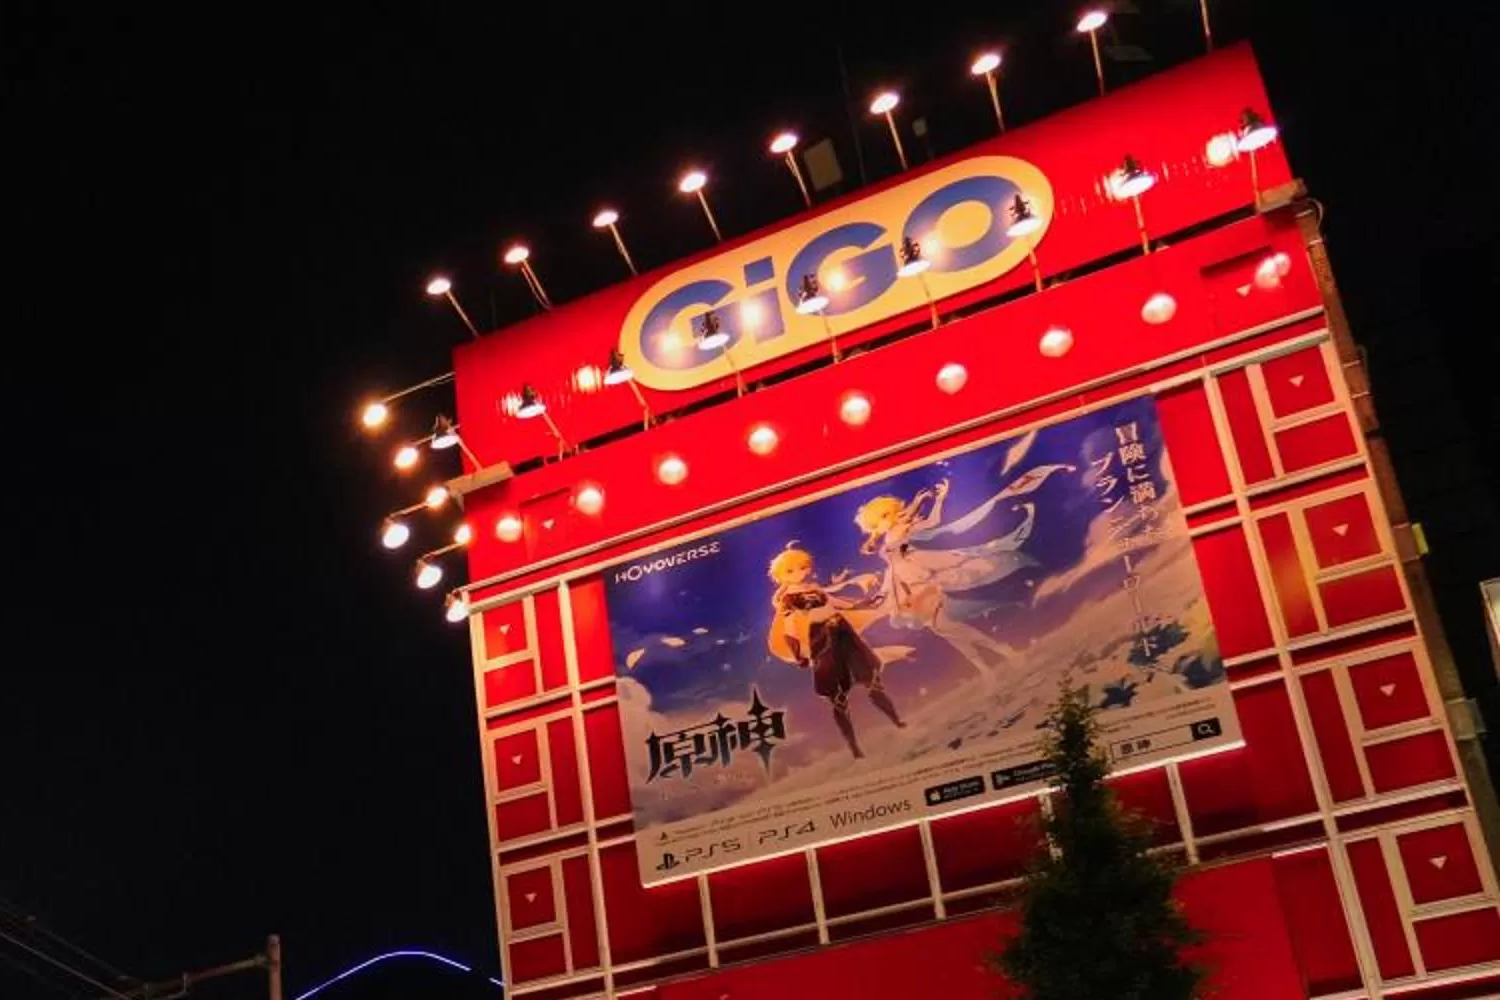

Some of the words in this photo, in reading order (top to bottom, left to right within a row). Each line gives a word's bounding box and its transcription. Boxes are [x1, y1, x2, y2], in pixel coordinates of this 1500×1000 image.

[639, 175, 1028, 369] GiGO
[614, 541, 721, 584] HOYOVERSE
[646, 684, 787, 785] 原神
[829, 799, 913, 830] Windows
